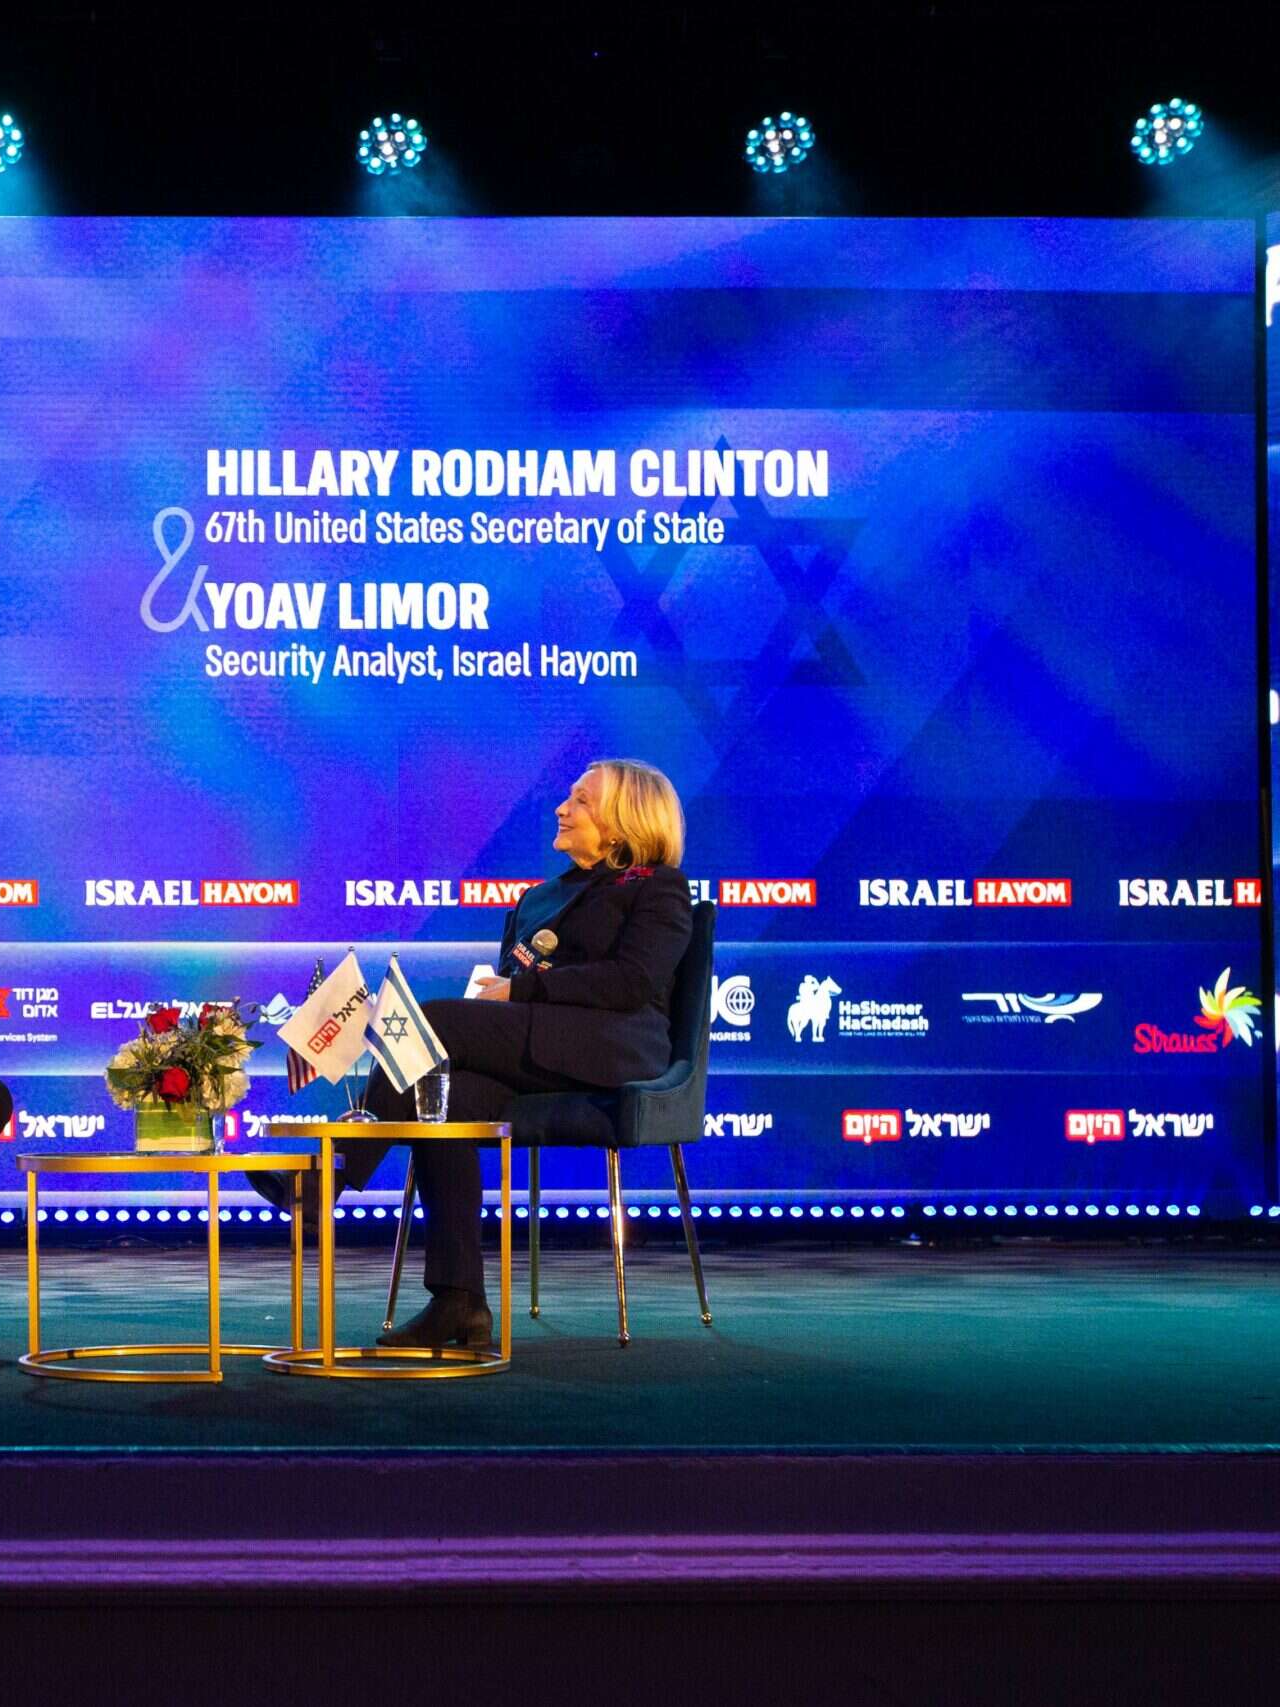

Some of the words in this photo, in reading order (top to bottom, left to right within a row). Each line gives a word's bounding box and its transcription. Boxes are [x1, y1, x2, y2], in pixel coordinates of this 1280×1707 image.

[206, 449, 399, 497] HILLARY
[411, 449, 616, 497] RODHAM
[629, 448, 829, 498] CLINTON
[204, 508, 265, 544] 67th
[274, 509, 367, 544] United
[375, 511, 464, 544] States
[470, 511, 610, 552] Secretary
[617, 509, 647, 544] of
[653, 511, 725, 544] State
[205, 582, 326, 630] YOAV
[339, 582, 489, 630] LIMOR
[205, 643, 326, 684] Security
[333, 642, 443, 684] Analyst,
[453, 642, 532, 677] Israel
[540, 645, 637, 684] Hayom
[84, 878, 200, 907] ISRAEL
[203, 881, 293, 904] HAYOM
[345, 878, 459, 907] ISRAEL
[722, 881, 812, 904] HAYOM
[859, 878, 973, 907] ISRAEL
[977, 881, 1067, 904] HAYOM
[1118, 878, 1233, 907] ISRAEL
[36, 988, 59, 1004] מגן
[333, 983, 369, 1022] שראל
[838, 1000, 923, 1016] HaShomer
[22, 1004, 58, 1018] אדום
[838, 1016, 929, 1031] HaChadash
[709, 1032, 751, 1042] NGRESS
[1133, 1023, 1218, 1053] Strauss
[18, 1109, 105, 1138] ישראל
[704, 1112, 773, 1137] ישרא
[905, 1108, 991, 1137] ישראל
[1128, 1108, 1214, 1137] ישראל
